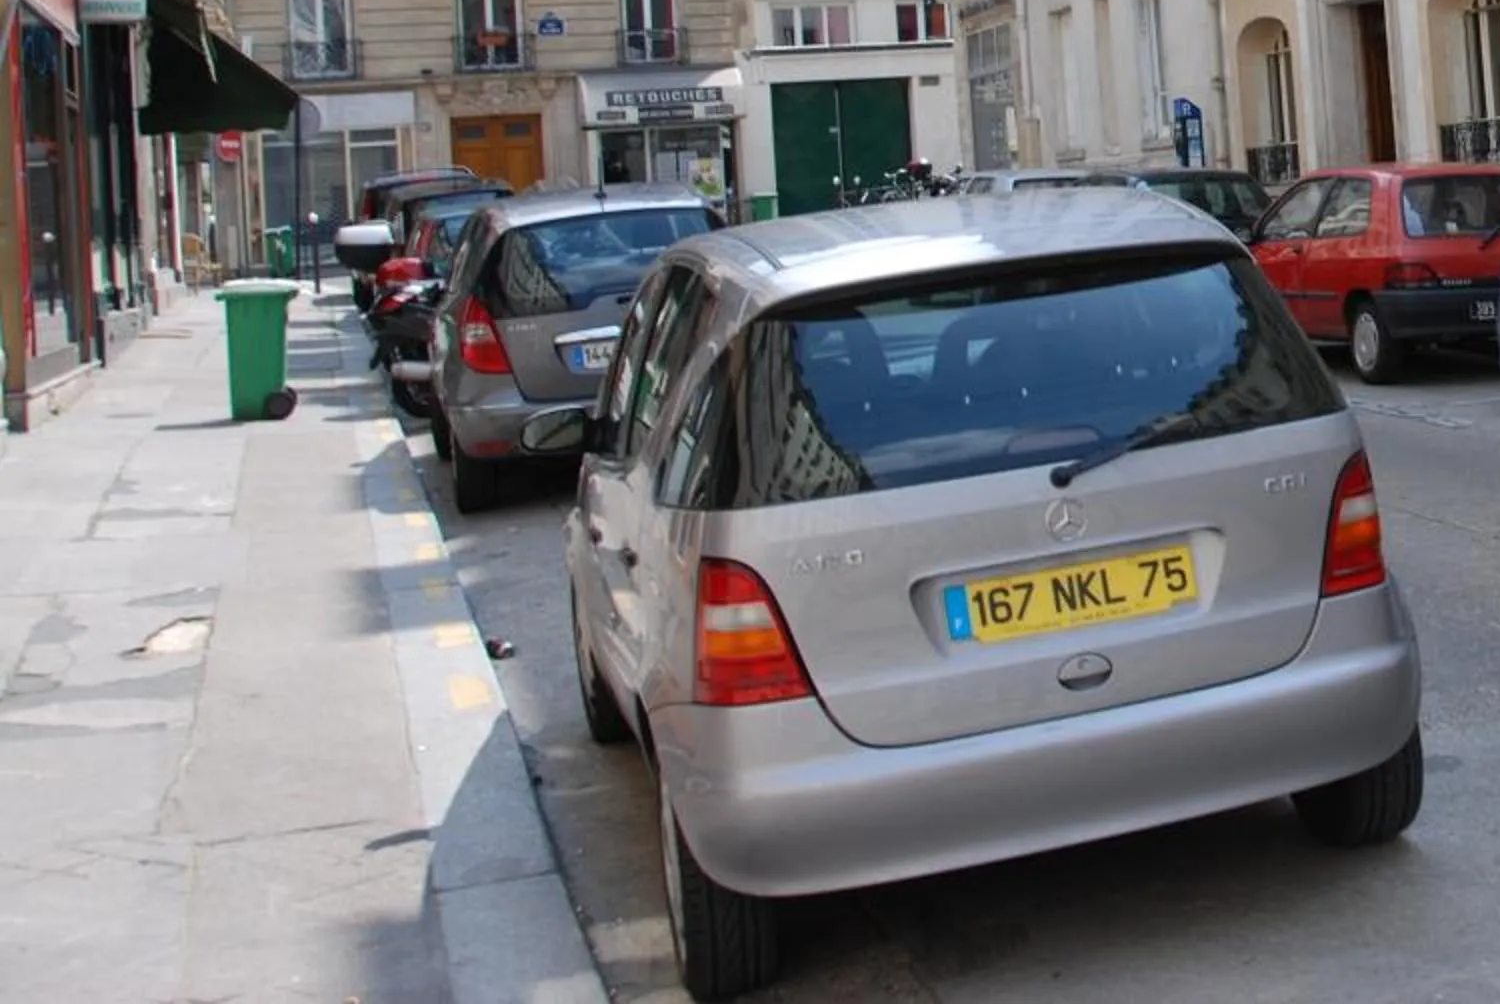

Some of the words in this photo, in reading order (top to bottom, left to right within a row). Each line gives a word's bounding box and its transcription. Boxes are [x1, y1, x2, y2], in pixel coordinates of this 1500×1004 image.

[612, 88, 717, 105] RETOUCHES
[971, 582, 1034, 627] 167
[1051, 568, 1126, 613] NKL
[1138, 556, 1188, 597] 75
